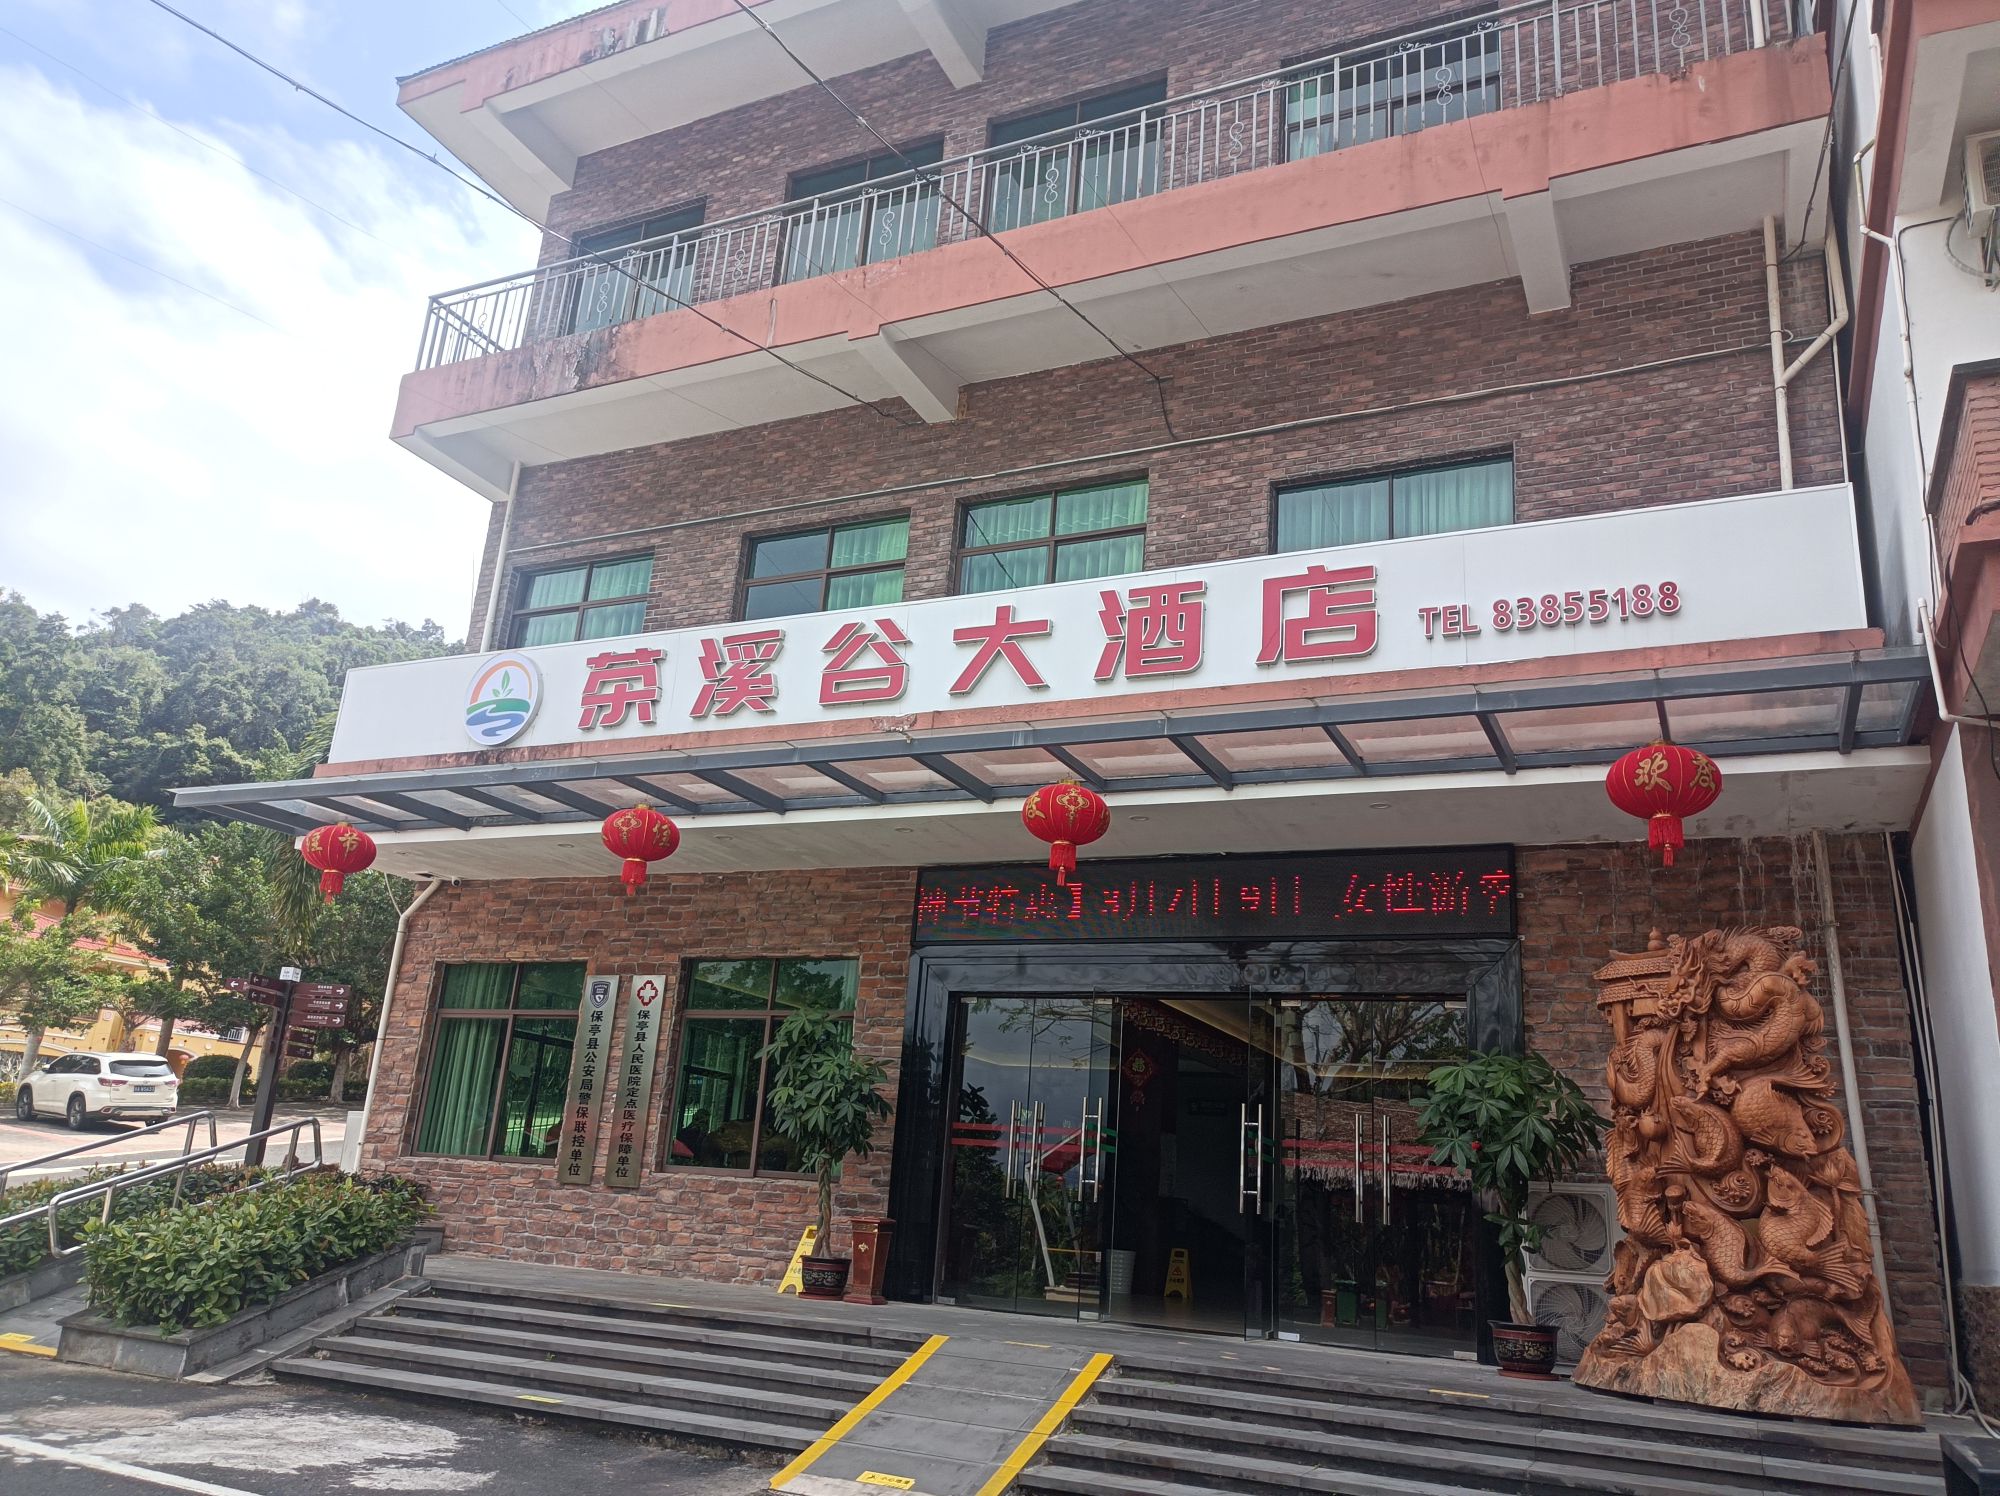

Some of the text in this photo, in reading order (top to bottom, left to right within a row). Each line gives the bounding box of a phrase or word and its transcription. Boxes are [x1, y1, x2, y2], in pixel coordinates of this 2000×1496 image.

[579, 565, 1378, 730] 茶溪谷大酒店
[1418, 581, 1681, 641] TEL 83855188
[568, 1010, 604, 1176] 保亭县公安局警保联控单位
[615, 1010, 651, 1178] 保亭县人民医院定点医疗保障单位
